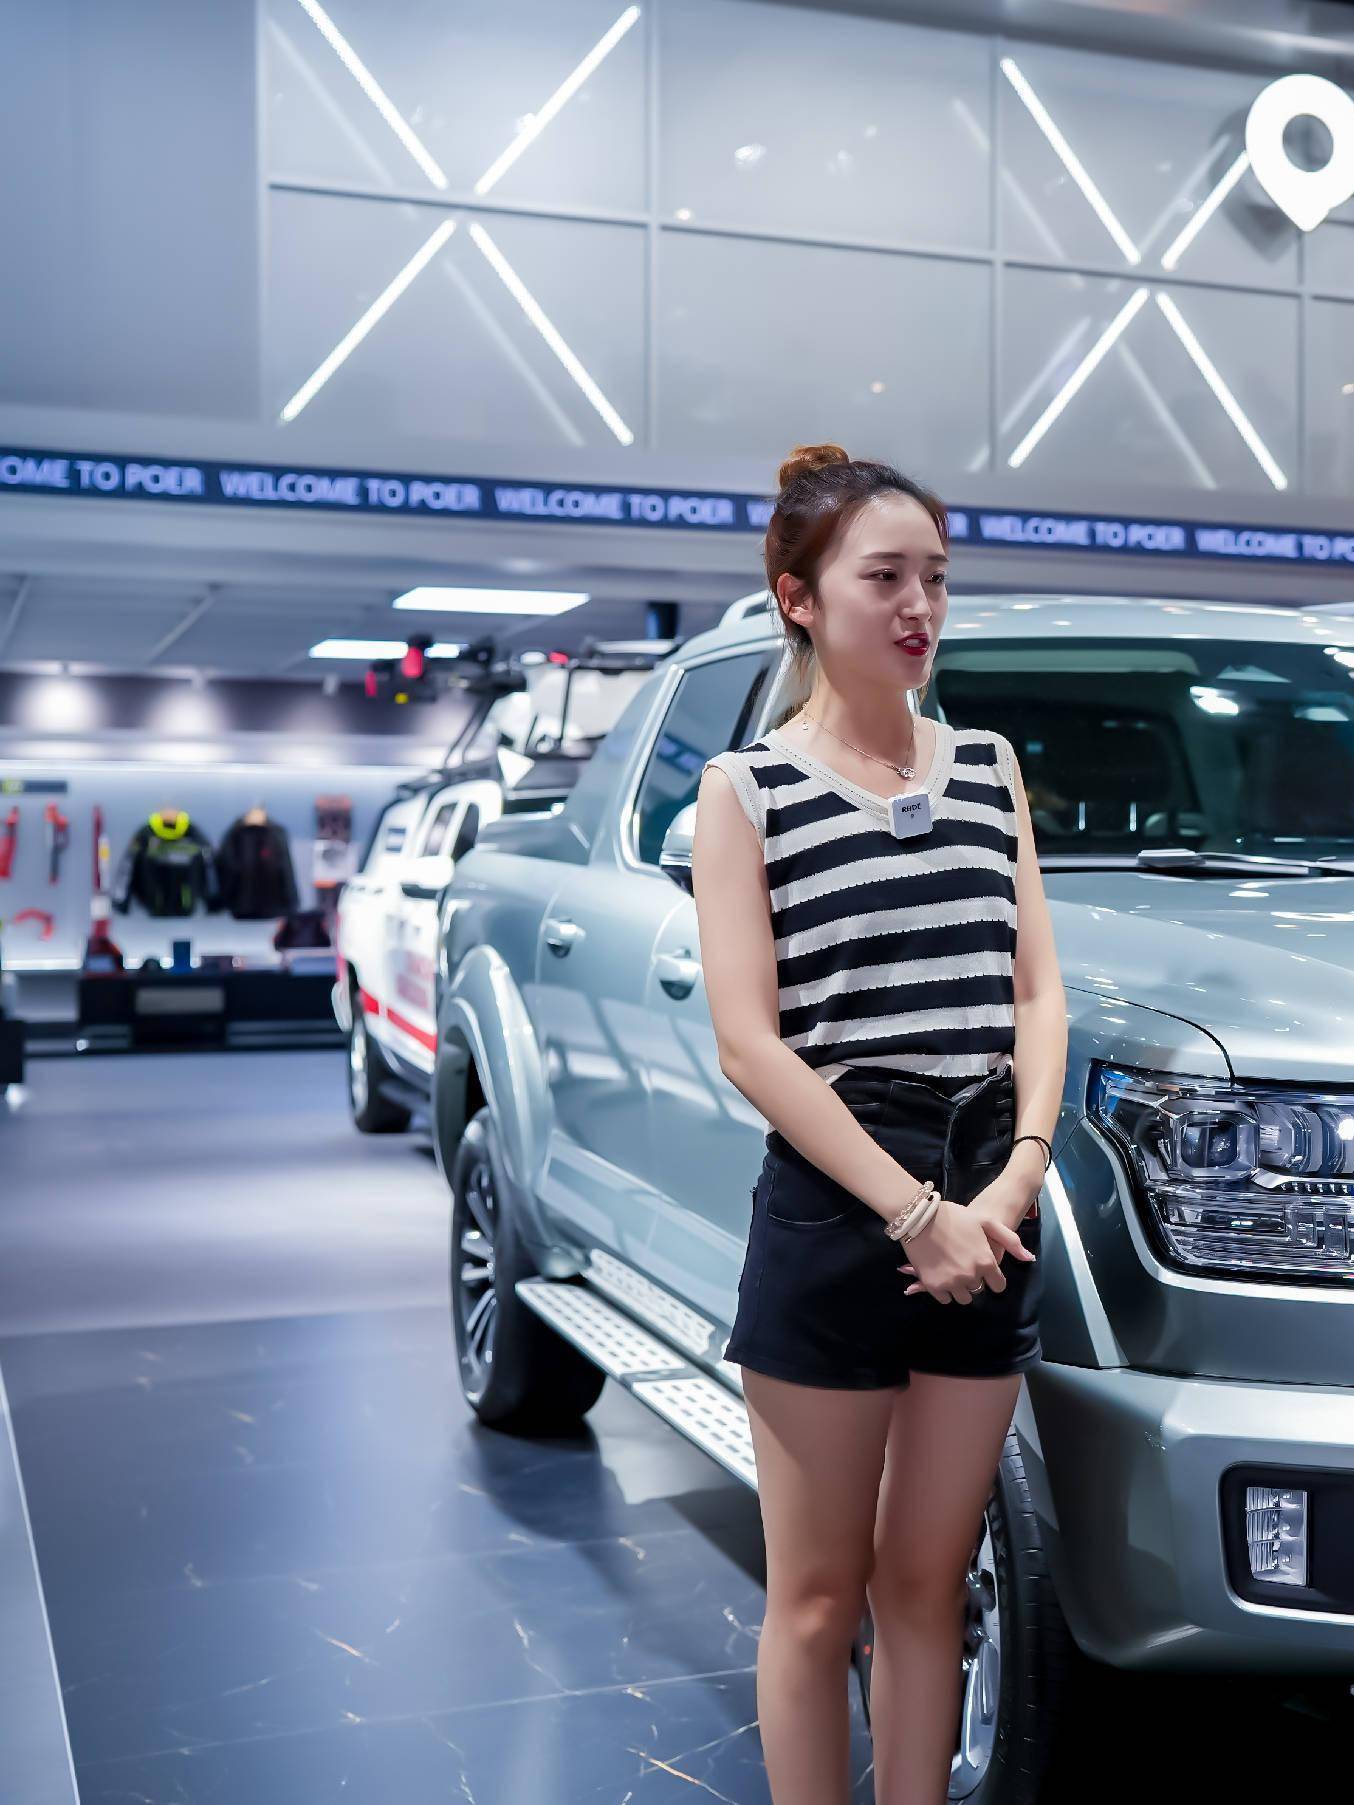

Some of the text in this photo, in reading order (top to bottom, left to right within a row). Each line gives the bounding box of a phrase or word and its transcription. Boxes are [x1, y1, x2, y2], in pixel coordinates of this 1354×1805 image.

[74, 460, 119, 491] TO
[124, 463, 204, 495] POER
[219, 470, 359, 505] WELCOME
[365, 480, 404, 507] TO
[407, 480, 481, 511] POER
[494, 487, 624, 519] WELCOME
[625, 494, 664, 522] TO
[666, 496, 735, 525] POER
[979, 515, 1090, 546] WELCOME
[1094, 520, 1125, 548] TO
[1126, 523, 1186, 550] POER
[1195, 528, 1299, 558] WELCOME
[1302, 534, 1331, 560] TO
